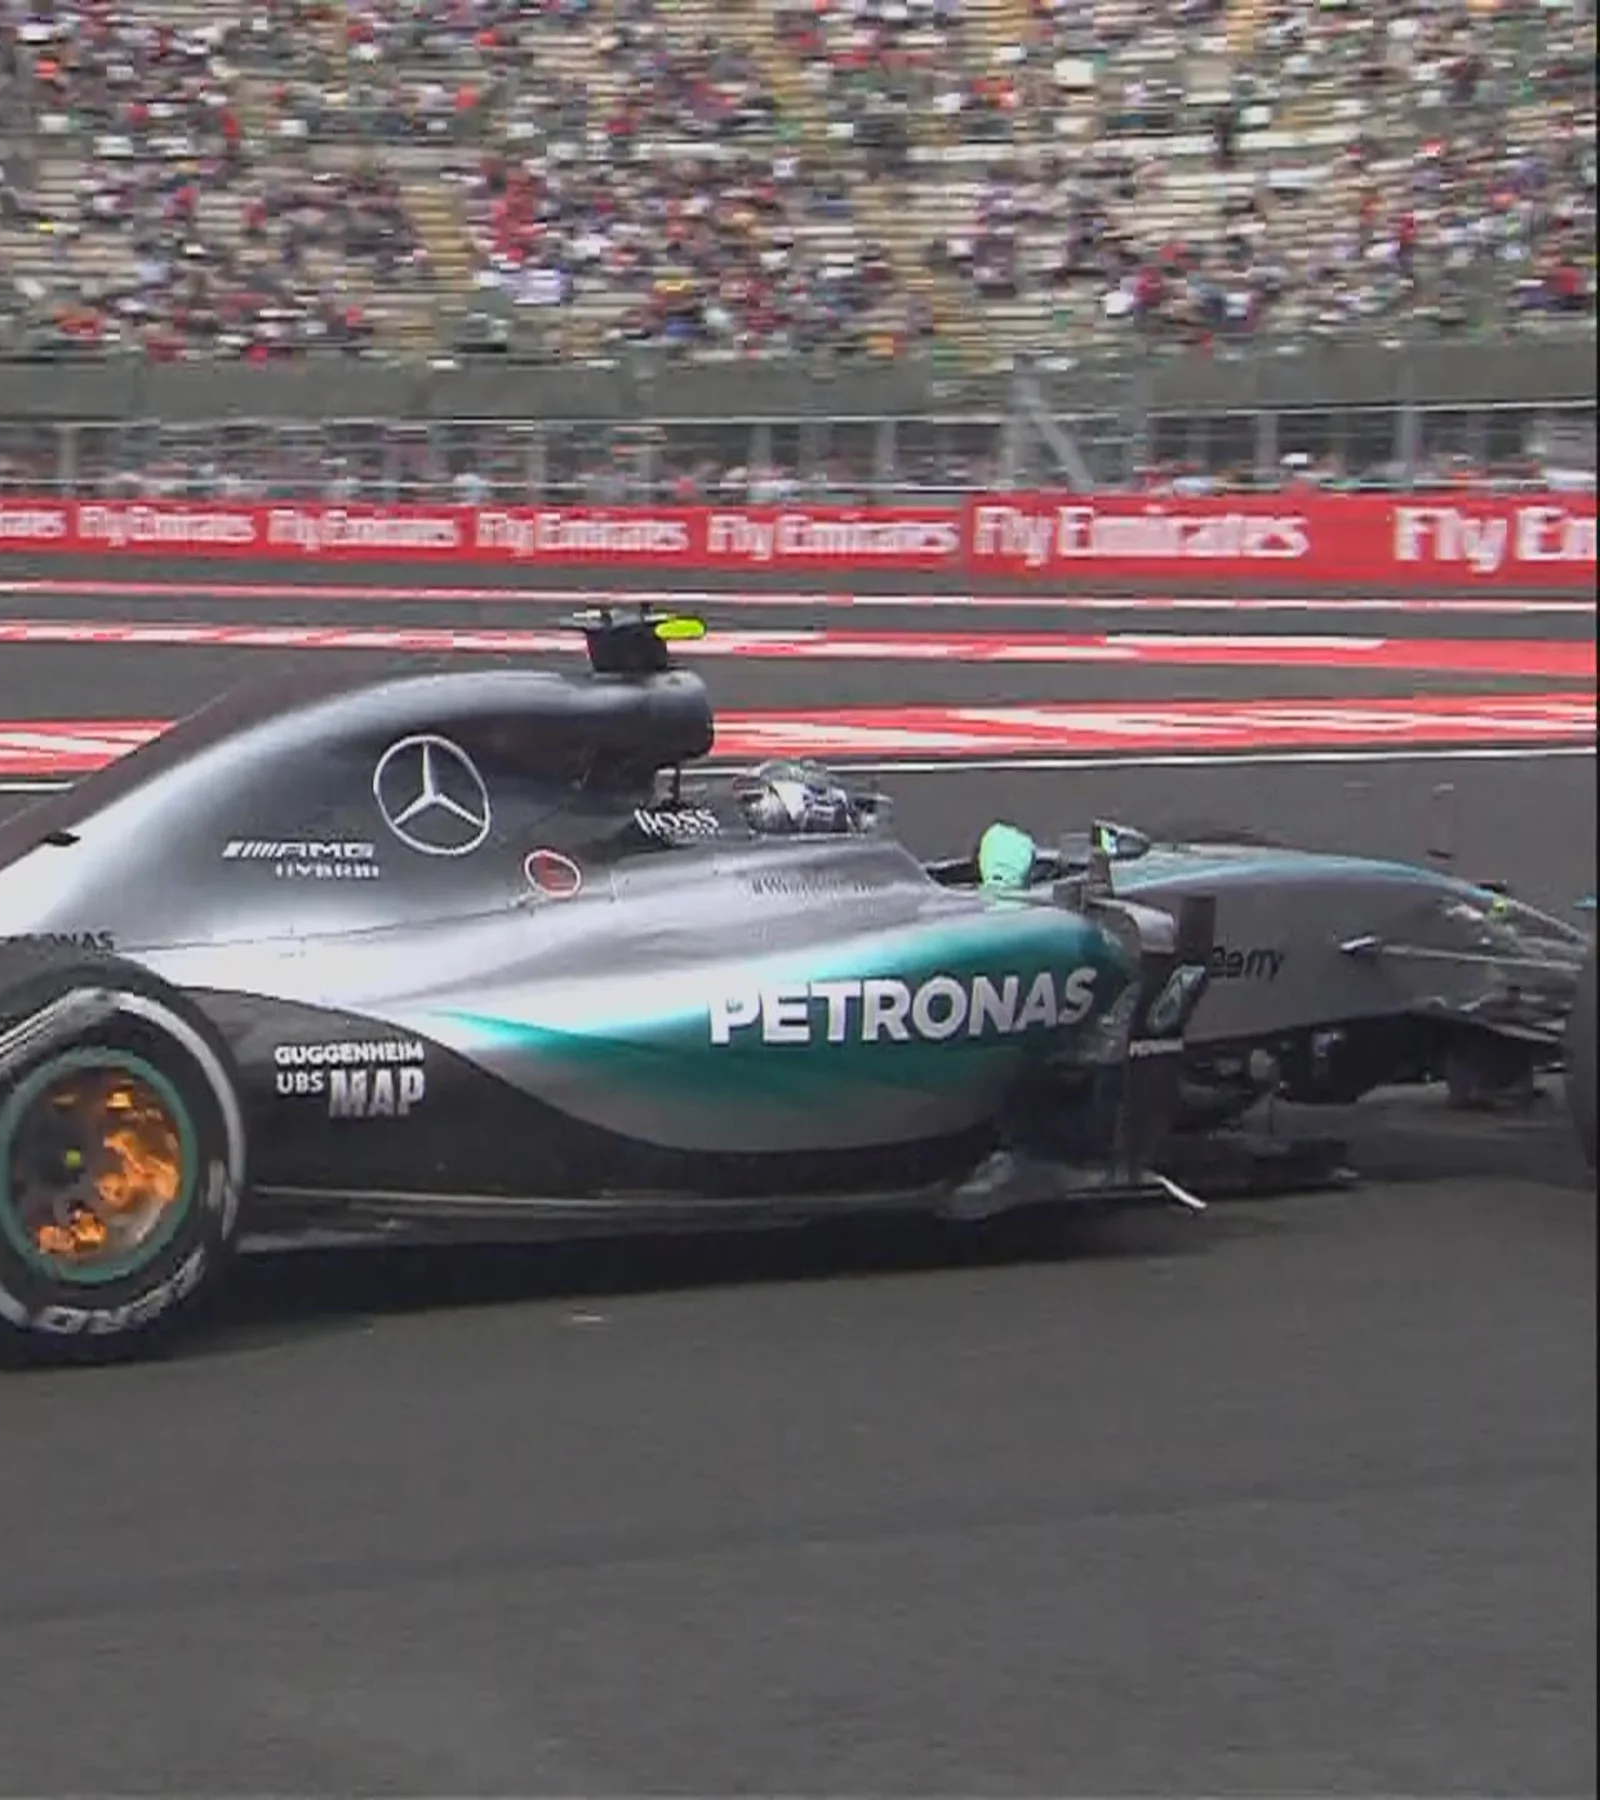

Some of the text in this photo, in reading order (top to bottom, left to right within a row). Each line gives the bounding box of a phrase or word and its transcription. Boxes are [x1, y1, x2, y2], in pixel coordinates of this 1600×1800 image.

[707, 514, 773, 561] Fly
[973, 506, 1054, 567] Fly
[1393, 507, 1506, 573] Fly
[708, 966, 1099, 1045] PETRONAS
[274, 1041, 425, 1065] GUGGENHEIM
[275, 1066, 425, 1118] UBS MAP
